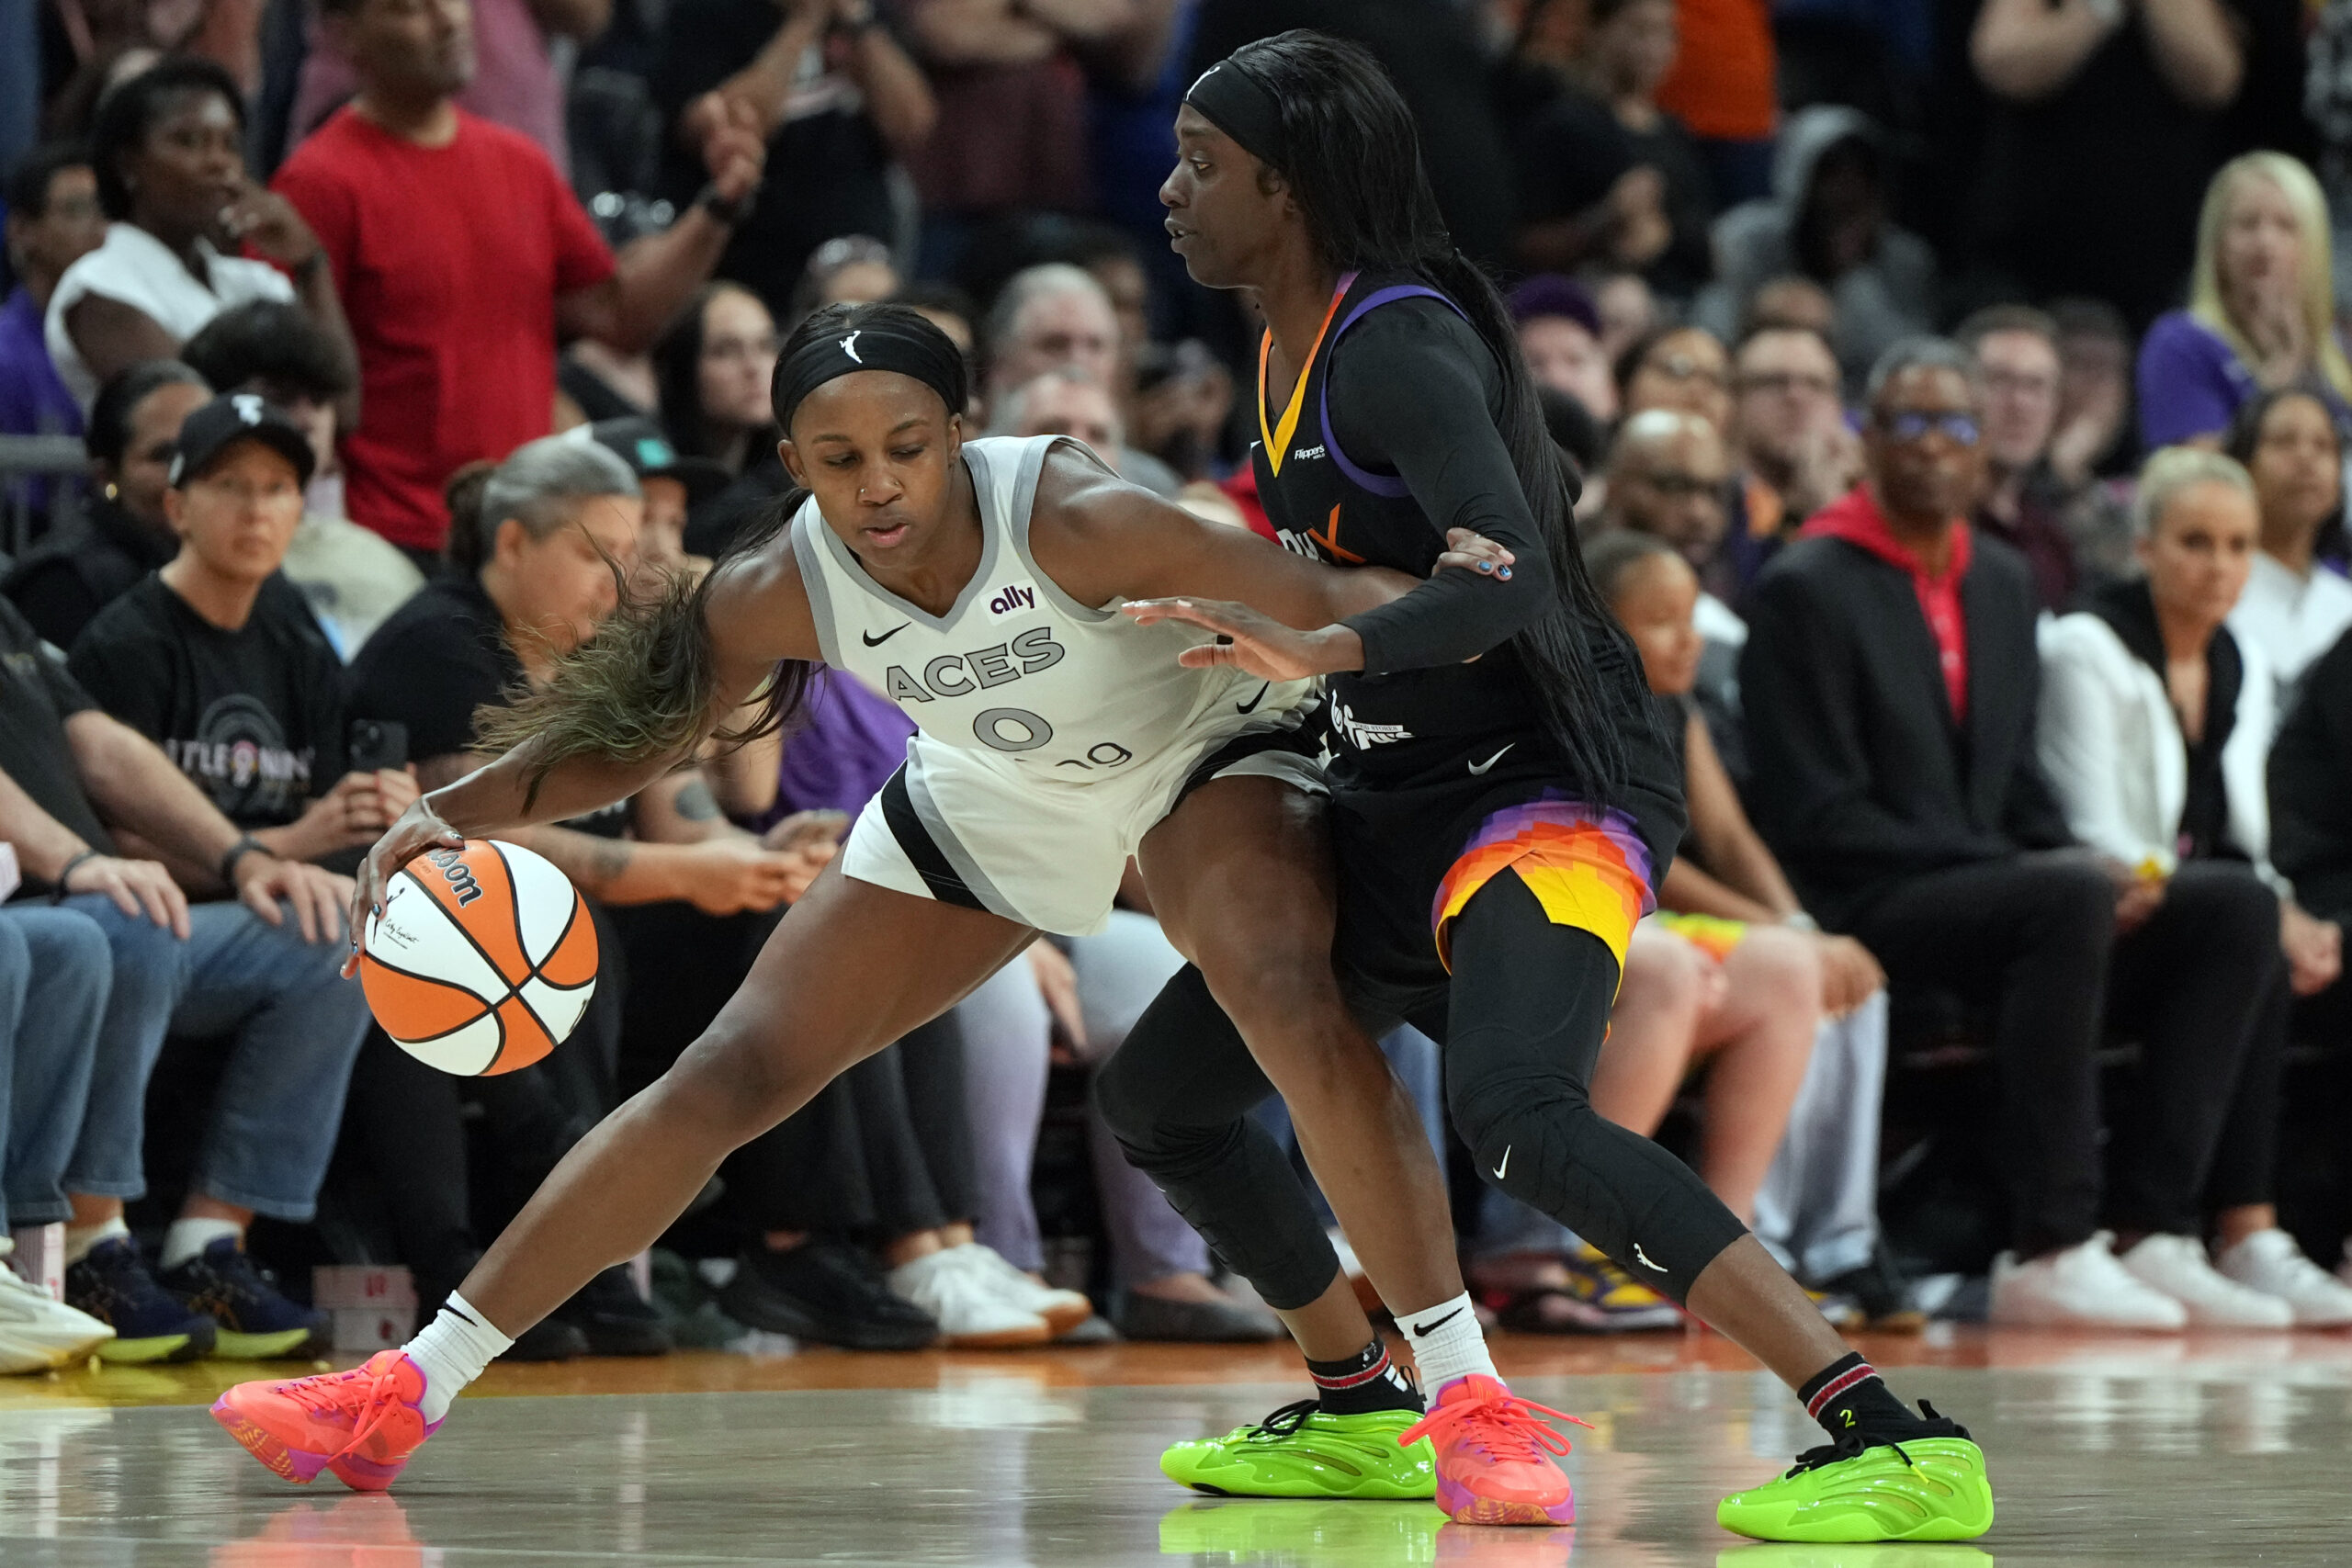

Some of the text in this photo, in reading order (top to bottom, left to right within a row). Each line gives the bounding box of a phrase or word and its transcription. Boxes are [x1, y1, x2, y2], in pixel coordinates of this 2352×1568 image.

[1294, 444, 1325, 460] Flipper's
[989, 584, 1035, 615] ally
[887, 626, 1065, 703] ACES
[973, 707, 1053, 752] 0
[1839, 1408, 1856, 1428] 2
